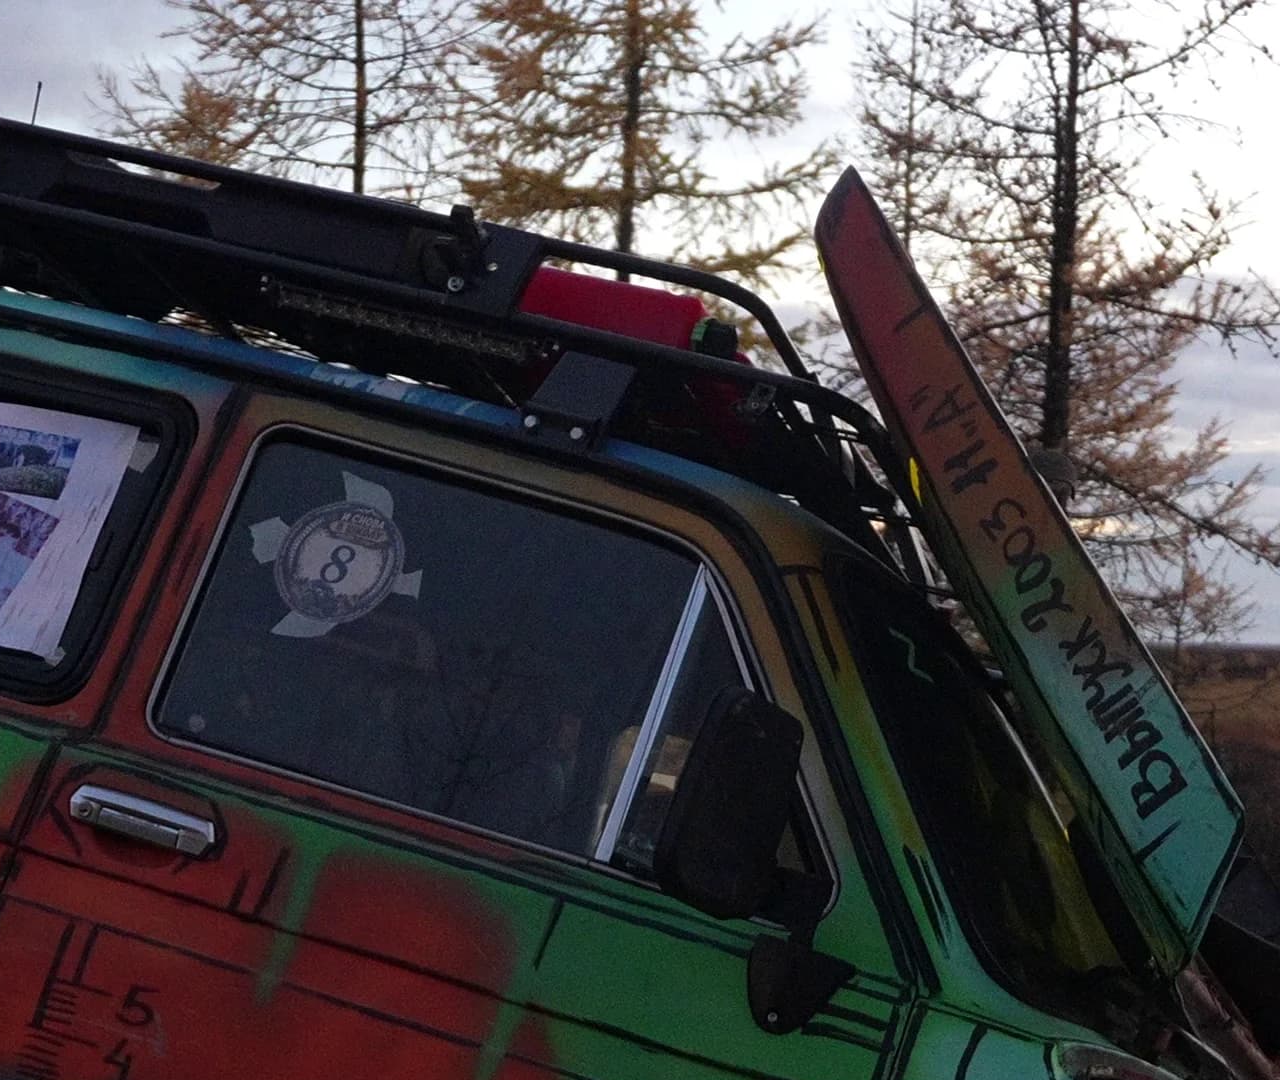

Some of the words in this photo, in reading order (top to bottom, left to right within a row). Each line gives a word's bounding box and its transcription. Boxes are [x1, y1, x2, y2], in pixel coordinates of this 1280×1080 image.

[320, 545, 356, 585] 8
[979, 497, 1074, 633] 2003
[115, 983, 161, 1027] 5
